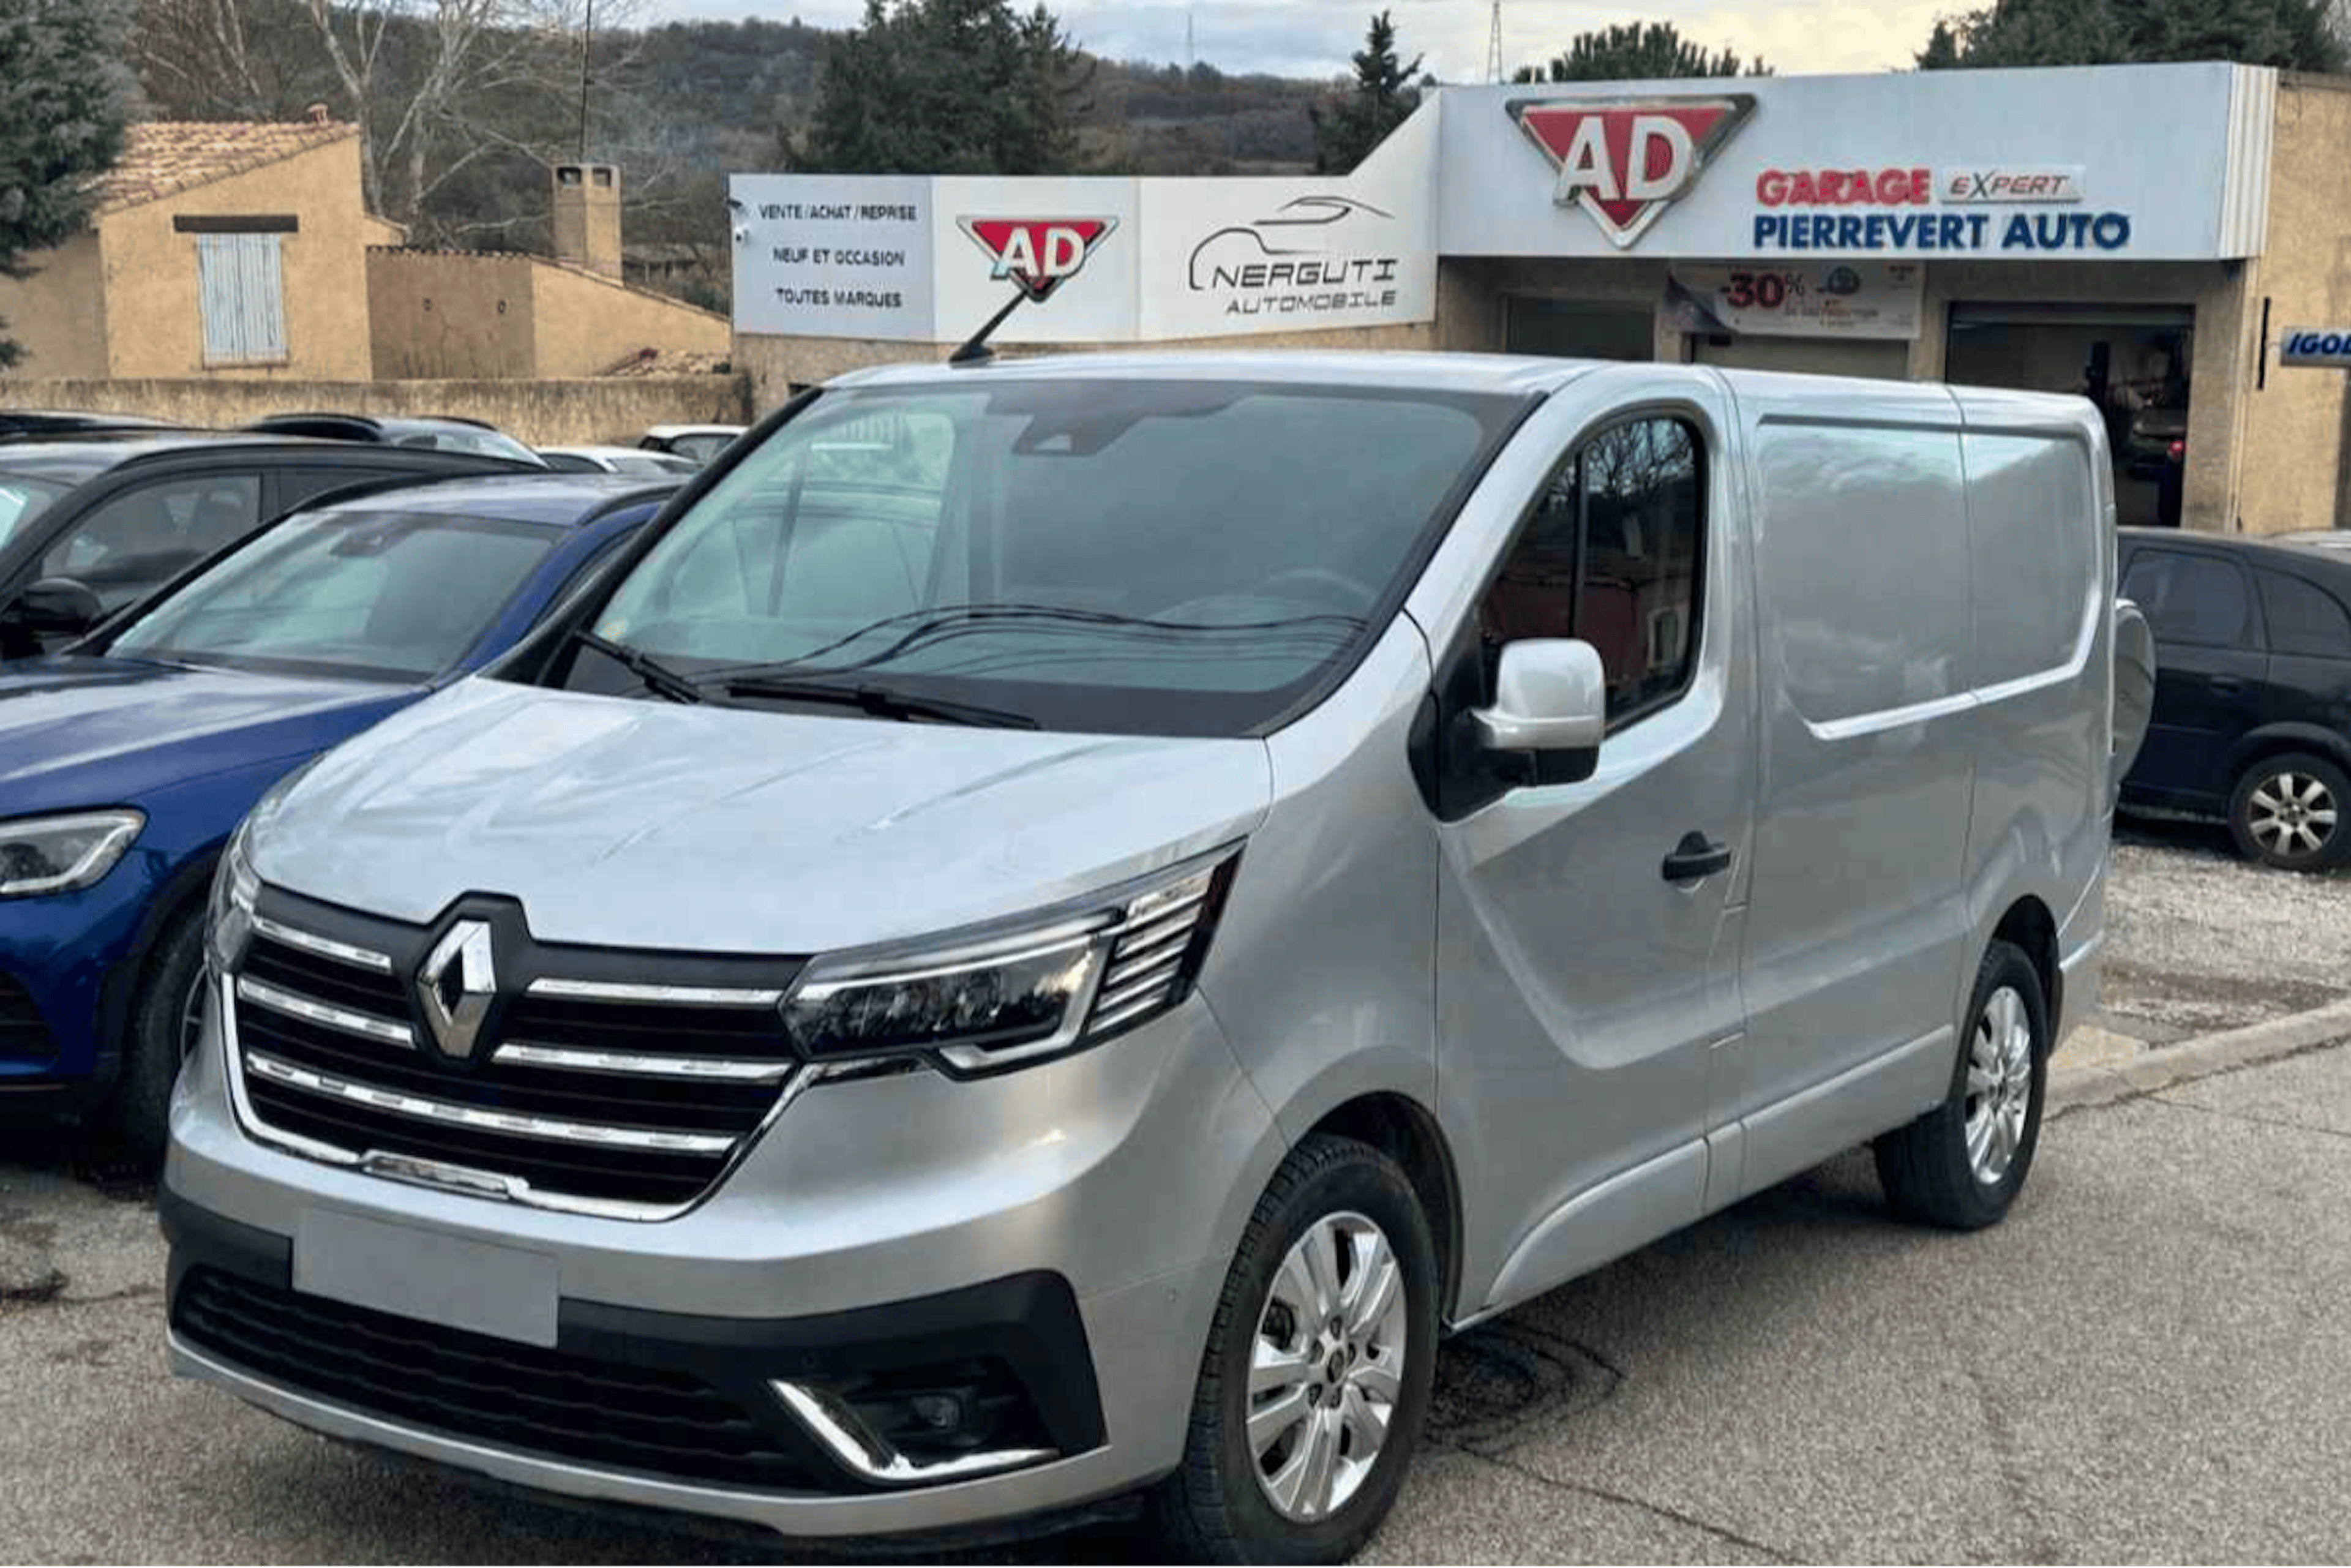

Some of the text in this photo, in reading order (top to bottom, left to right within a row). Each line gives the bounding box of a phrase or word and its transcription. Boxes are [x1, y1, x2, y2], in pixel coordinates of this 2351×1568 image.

[1553, 115, 1695, 204] AD
[1756, 168, 1930, 207] GARAGE
[1754, 212, 2132, 250] PIERREVERT AUTO
[772, 247, 905, 266] NEUF ET OCCASION
[990, 227, 1086, 279] AD
[1212, 258, 1398, 288] NERGUTI
[776, 287, 902, 308] TOUTES MARQUES
[1226, 290, 1397, 315] AUTOMOBILE
